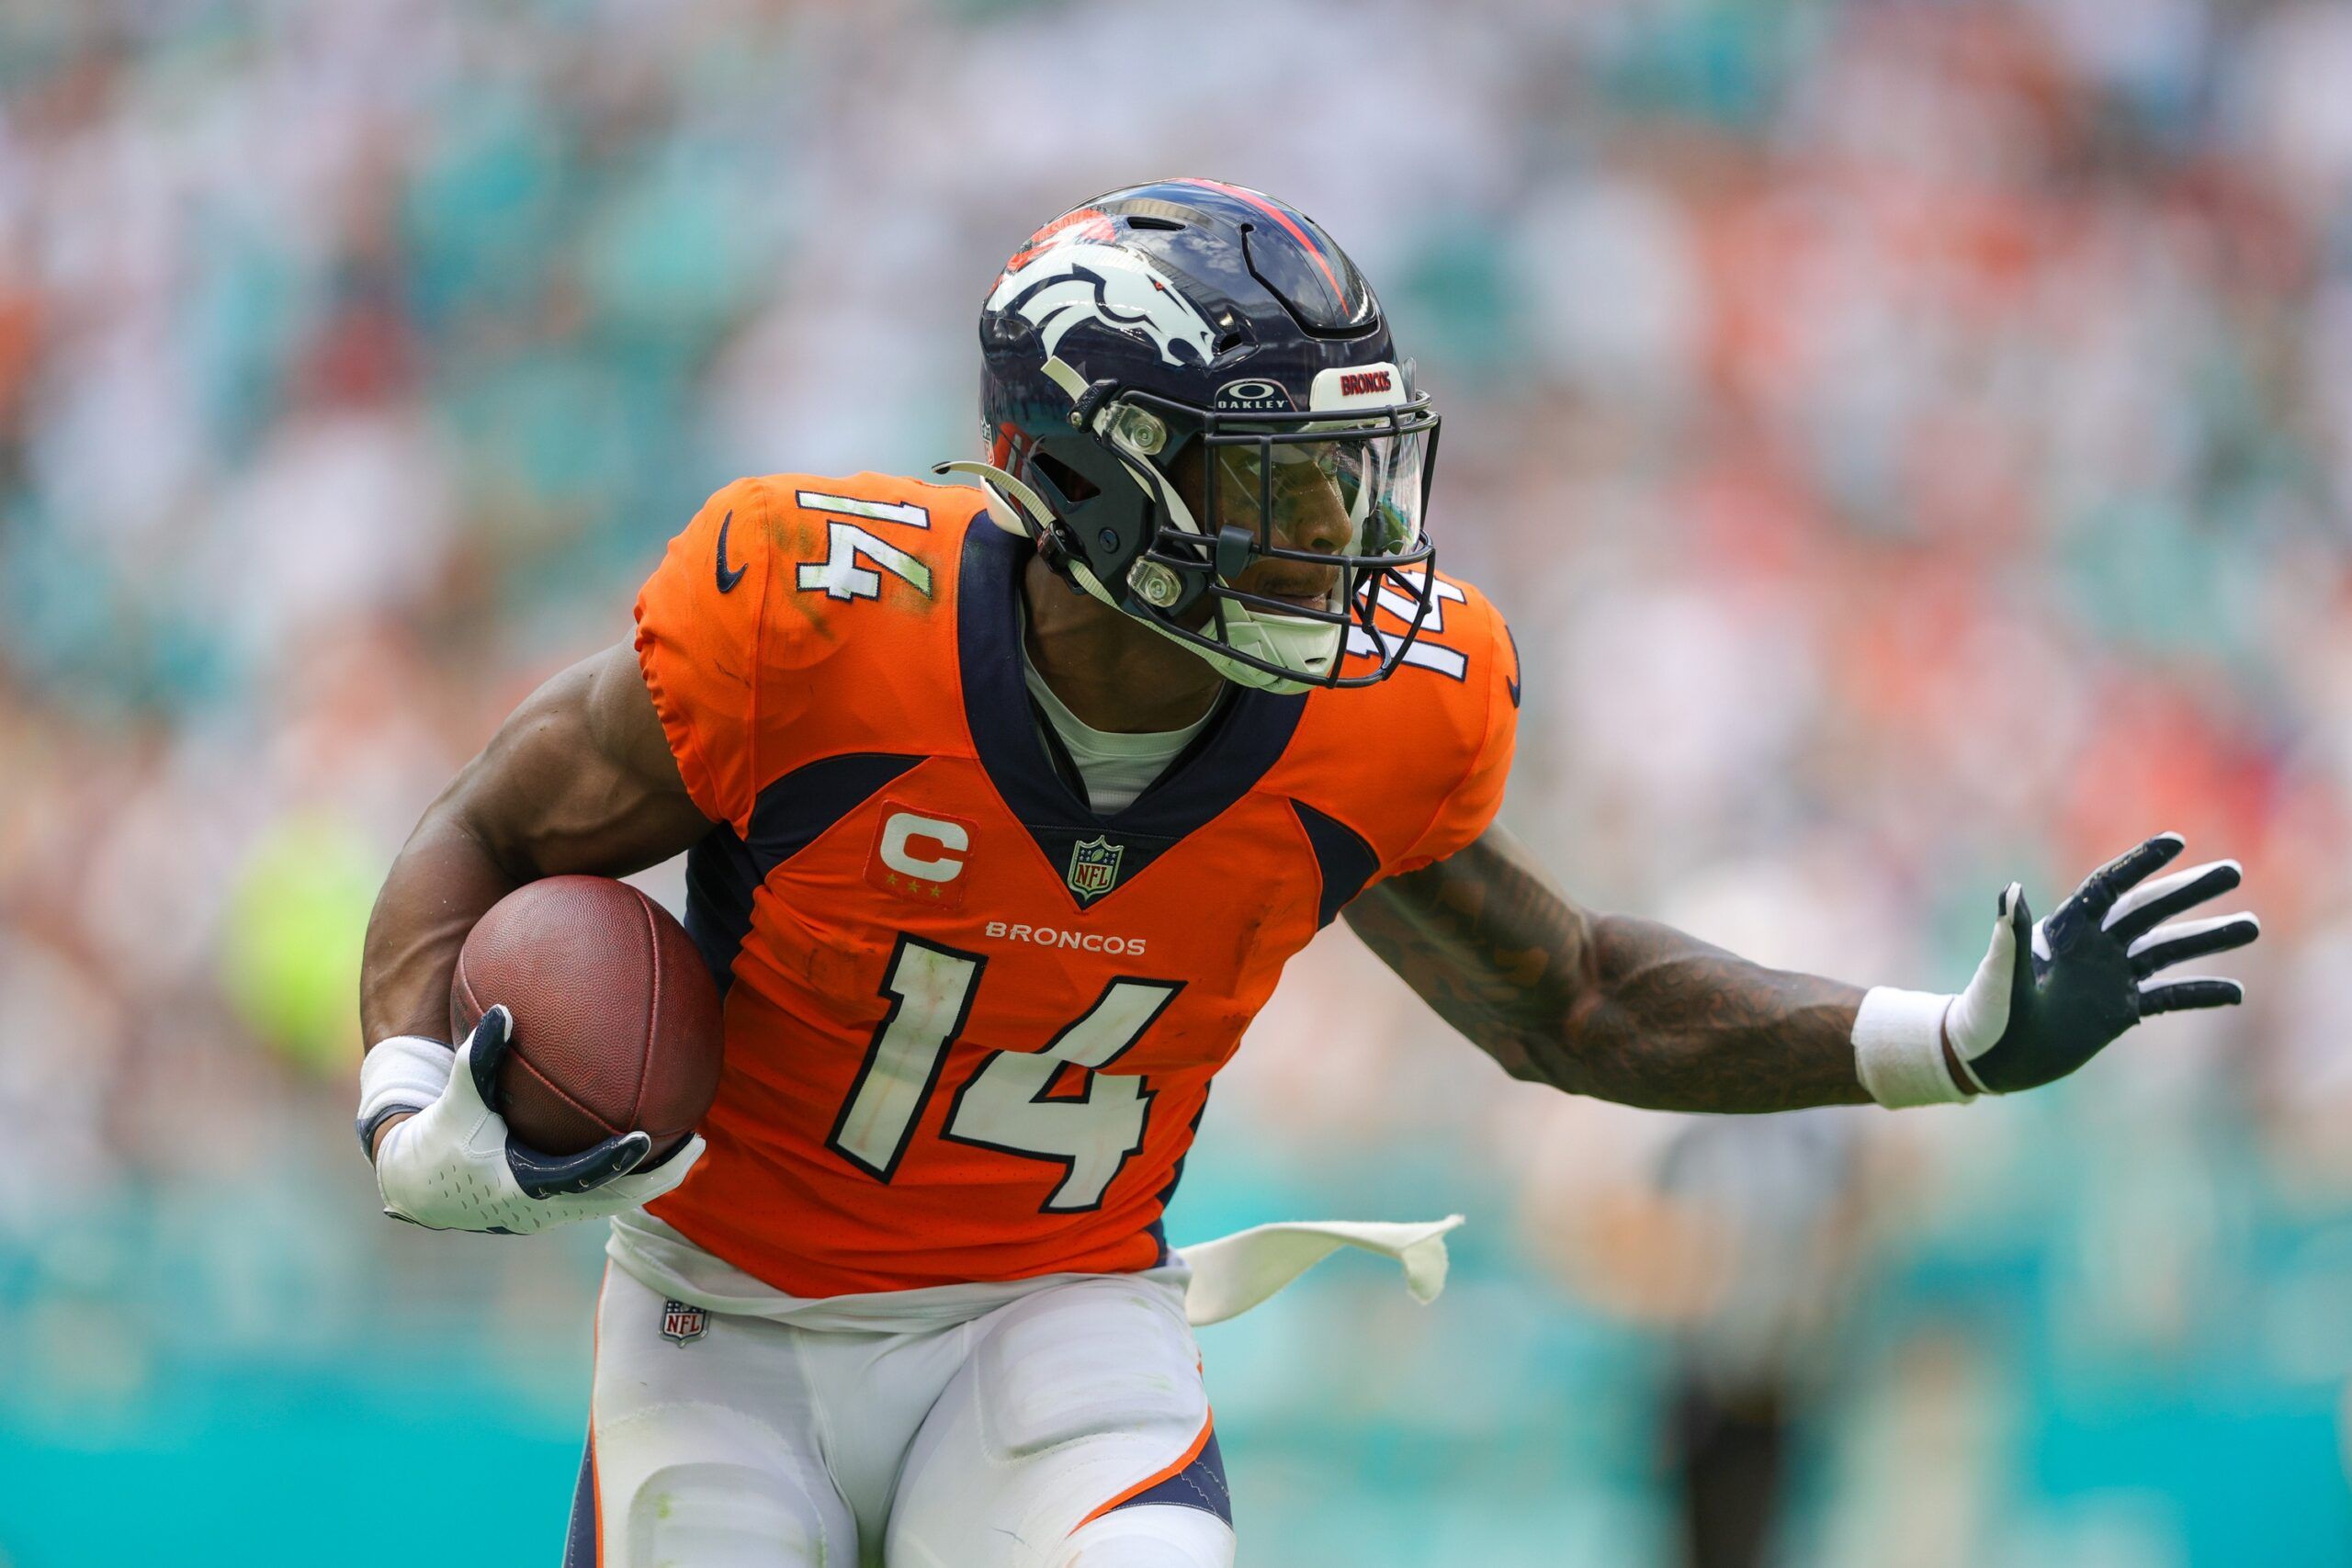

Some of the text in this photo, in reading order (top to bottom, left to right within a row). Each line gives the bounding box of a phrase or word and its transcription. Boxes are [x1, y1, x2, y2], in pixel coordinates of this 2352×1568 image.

[1340, 370, 1392, 397] BRONCOS
[1217, 400, 1286, 410] OAKLEY
[796, 490, 933, 604] 14
[1345, 569, 1469, 683] 14
[879, 812, 969, 883] C
[1076, 863, 1109, 888] NFL
[985, 921, 1147, 956] BRONCOS
[824, 931, 1189, 1214] 14
[666, 1314, 700, 1335] NFL
